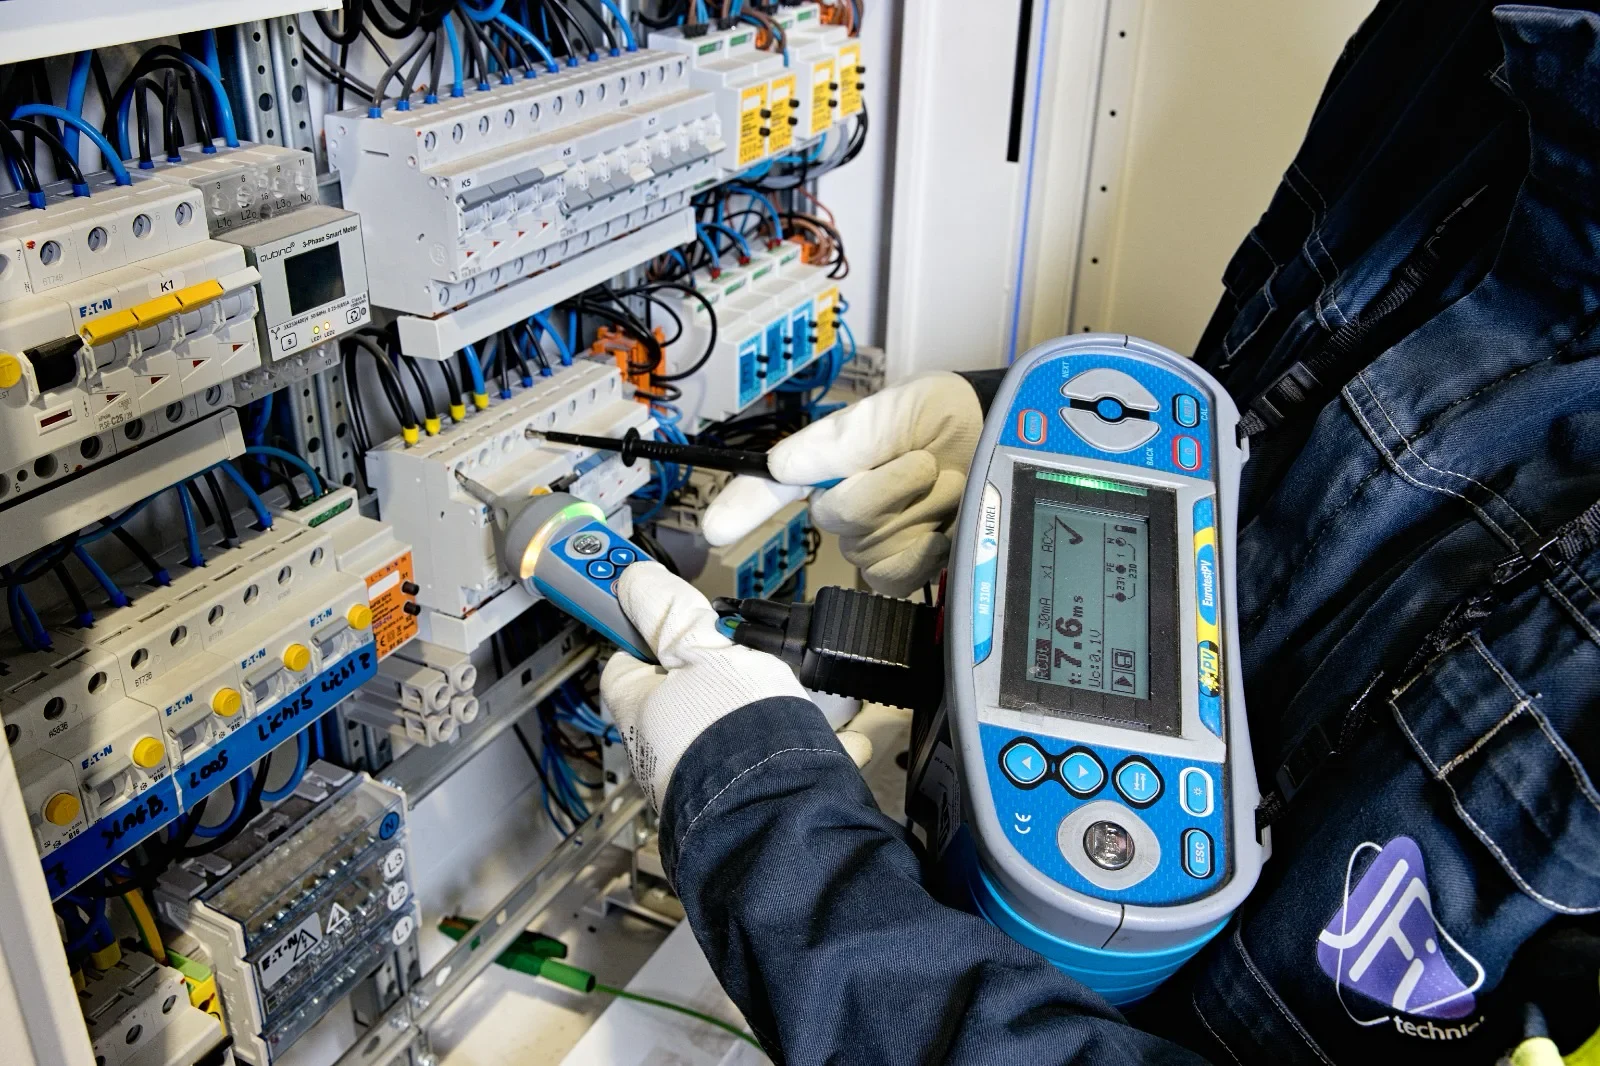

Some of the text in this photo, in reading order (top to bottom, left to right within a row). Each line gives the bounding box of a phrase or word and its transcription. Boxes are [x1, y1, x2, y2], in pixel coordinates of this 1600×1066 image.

[216, 181, 221, 189] 3
[241, 175, 246, 183] 6
[461, 179, 471, 188] K5
[302, 224, 358, 248] 3-Phase Smart Meter
[160, 279, 174, 293] K1
[1061, 361, 1069, 379] NEXT
[1146, 447, 1154, 467] BACK
[985, 506, 996, 537] METREL
[1106, 562, 1115, 573] PE
[1128, 563, 1137, 579] 230
[1116, 576, 1125, 591] 231
[1038, 597, 1051, 630] 30mA
[1203, 650, 1216, 671] PV
[385, 818, 394, 833] N
[1015, 812, 1031, 834] CE
[1195, 842, 1205, 864] ESC
[387, 853, 404, 873] L3
[391, 886, 405, 905] L2
[396, 921, 409, 940] L1
